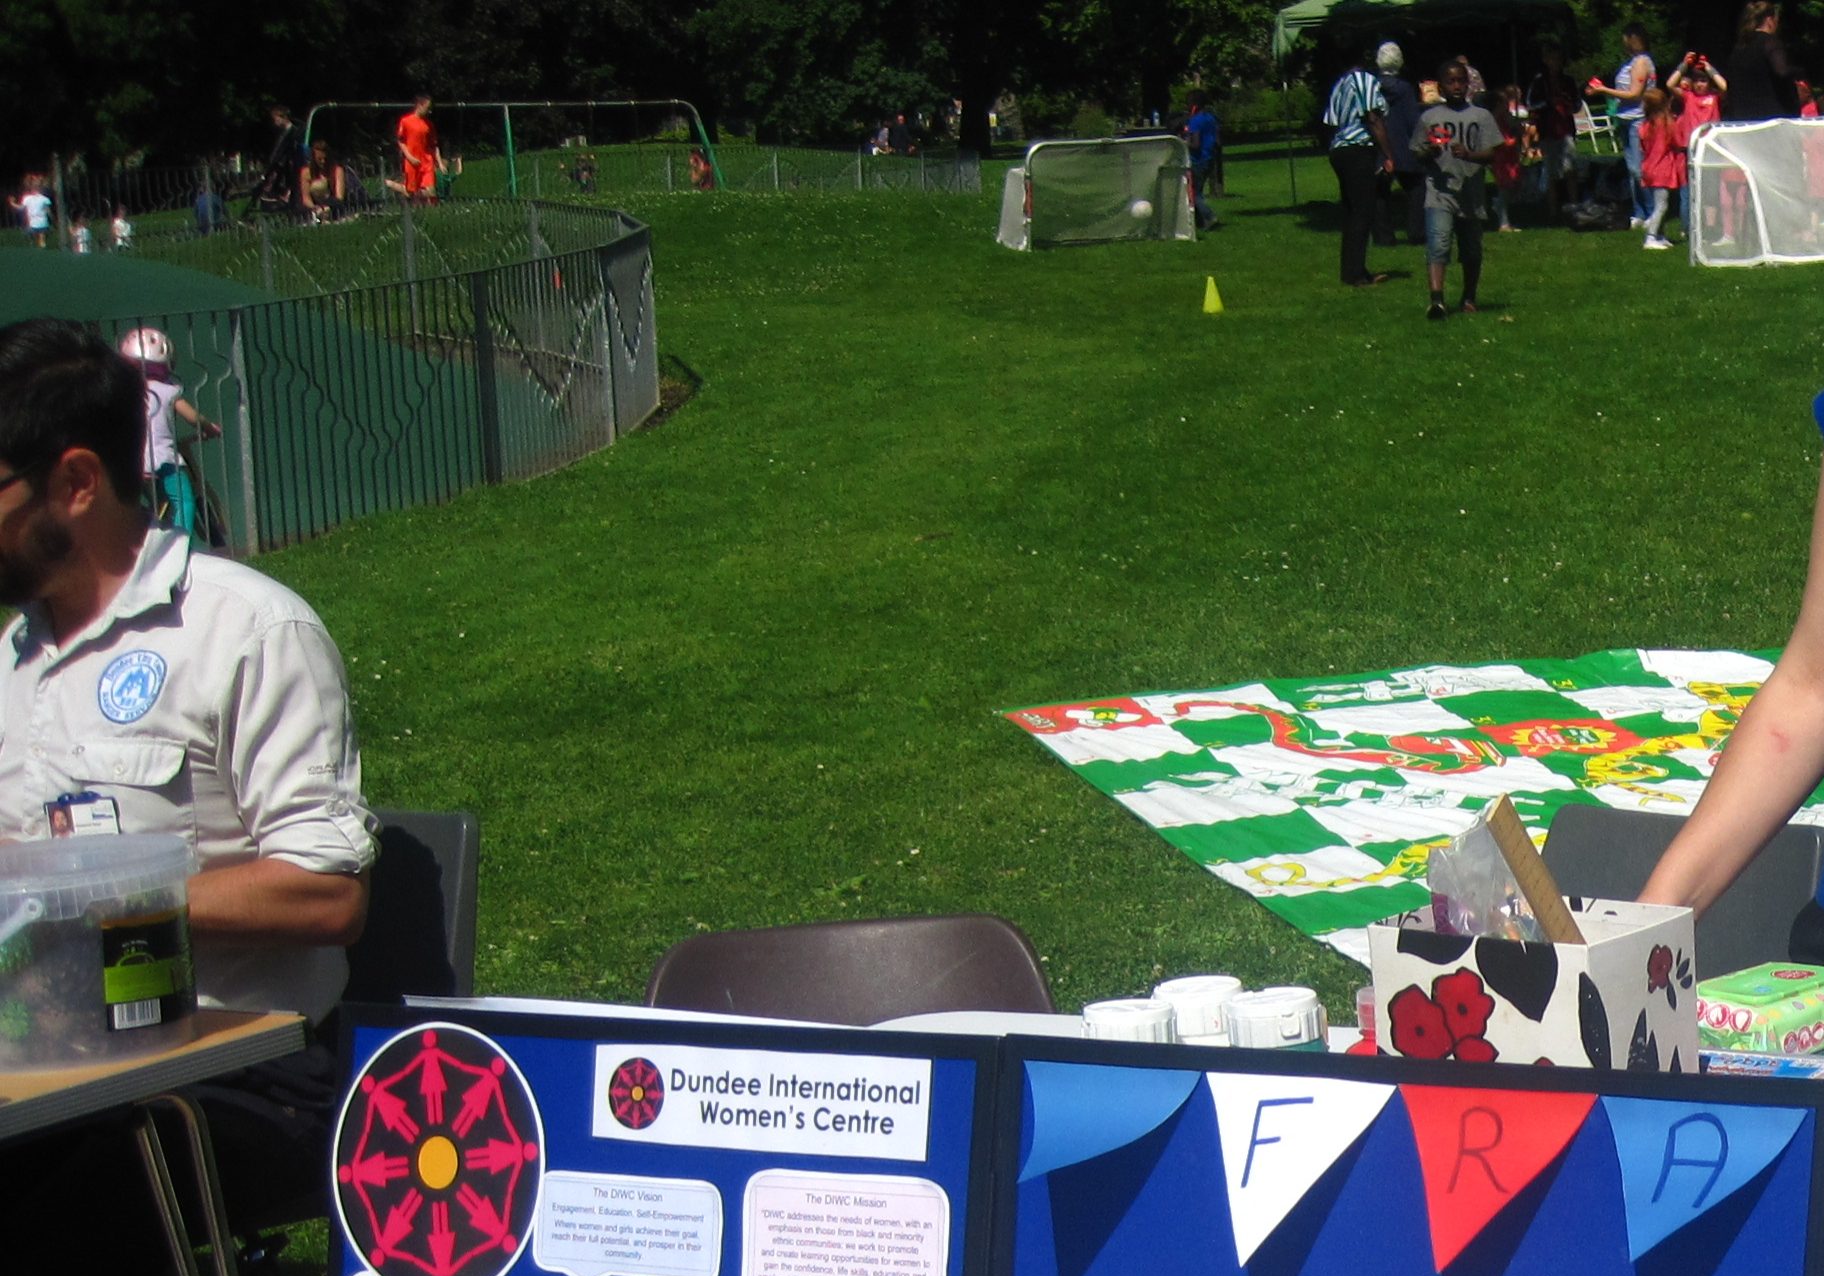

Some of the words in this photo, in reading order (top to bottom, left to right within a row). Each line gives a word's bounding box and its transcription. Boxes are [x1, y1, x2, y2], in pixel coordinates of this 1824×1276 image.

[670, 1067, 762, 1097] Dundee
[769, 1073, 921, 1105] International
[699, 1100, 806, 1130] Women's
[813, 1106, 895, 1136] Centre
[1241, 1096, 1314, 1188] F
[1448, 1107, 1508, 1193] R
[1653, 1112, 1729, 1209] A
[593, 1186, 609, 1199] The
[610, 1188, 635, 1201] DIWC
[637, 1190, 663, 1203] Vision
[805, 1192, 823, 1205] The
[824, 1194, 851, 1207] DIWC
[853, 1195, 888, 1209] Mission
